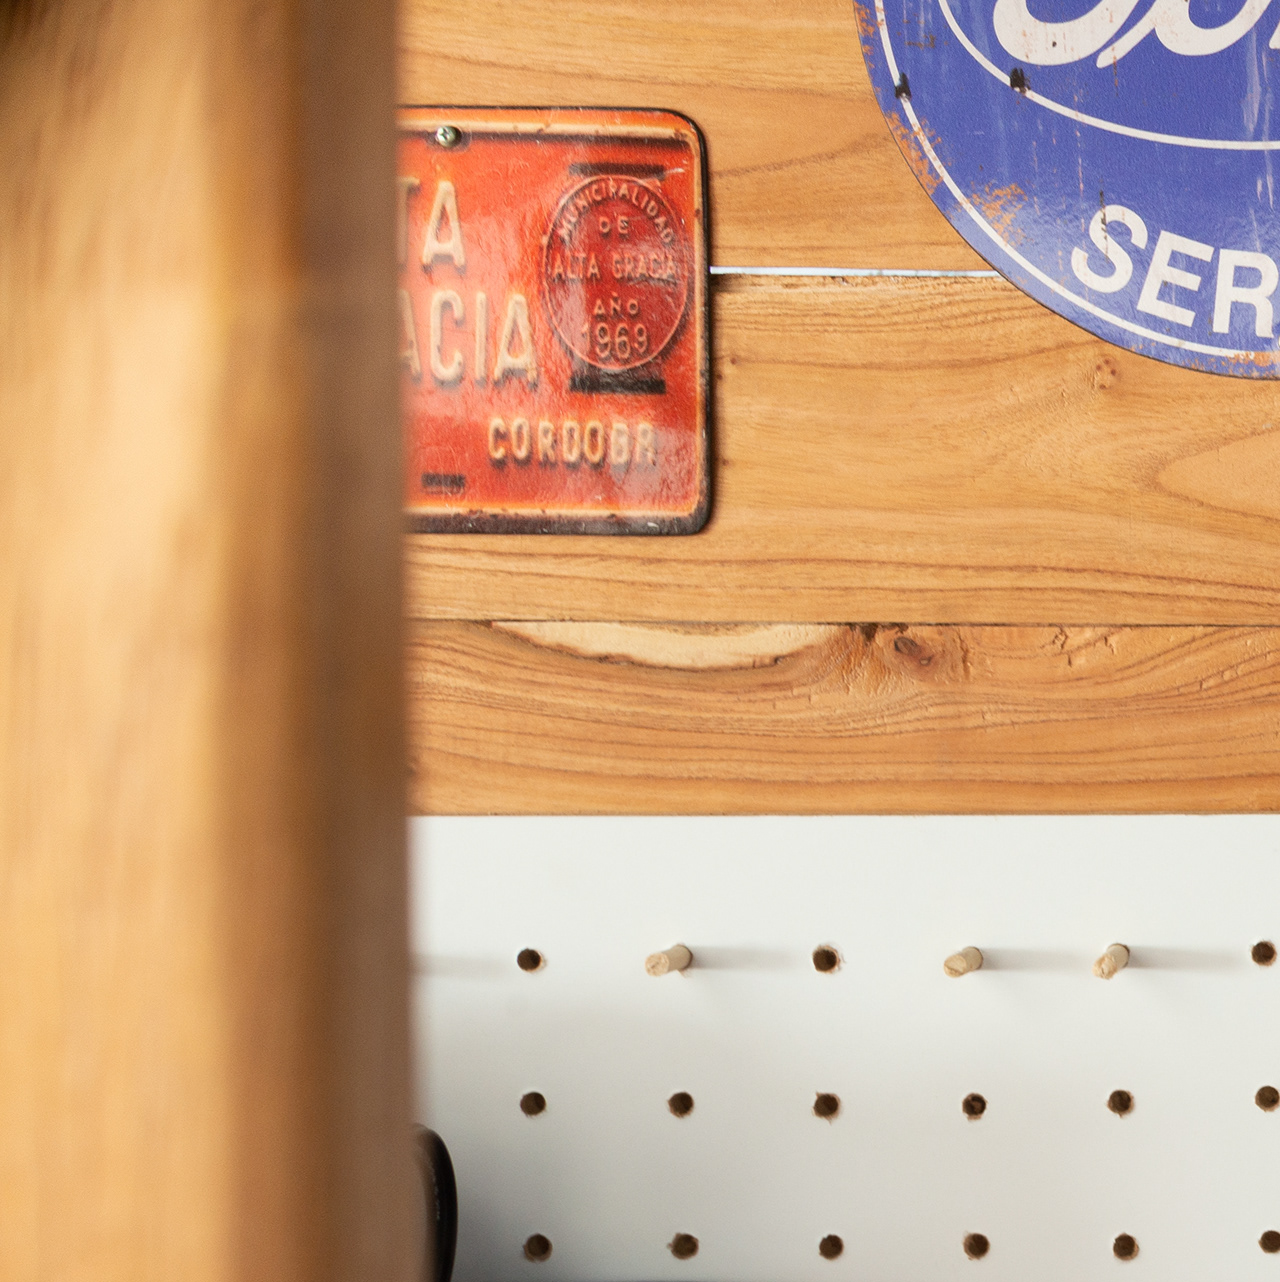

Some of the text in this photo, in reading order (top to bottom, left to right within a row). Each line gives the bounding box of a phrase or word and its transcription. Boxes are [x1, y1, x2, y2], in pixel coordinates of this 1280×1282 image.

[557, 180, 674, 244] MUNICIPALIDAD
[599, 215, 630, 234] DE
[552, 251, 676, 281] ALTA GRACIA
[594, 291, 640, 317] AÑO
[582, 322, 648, 359] 1969
